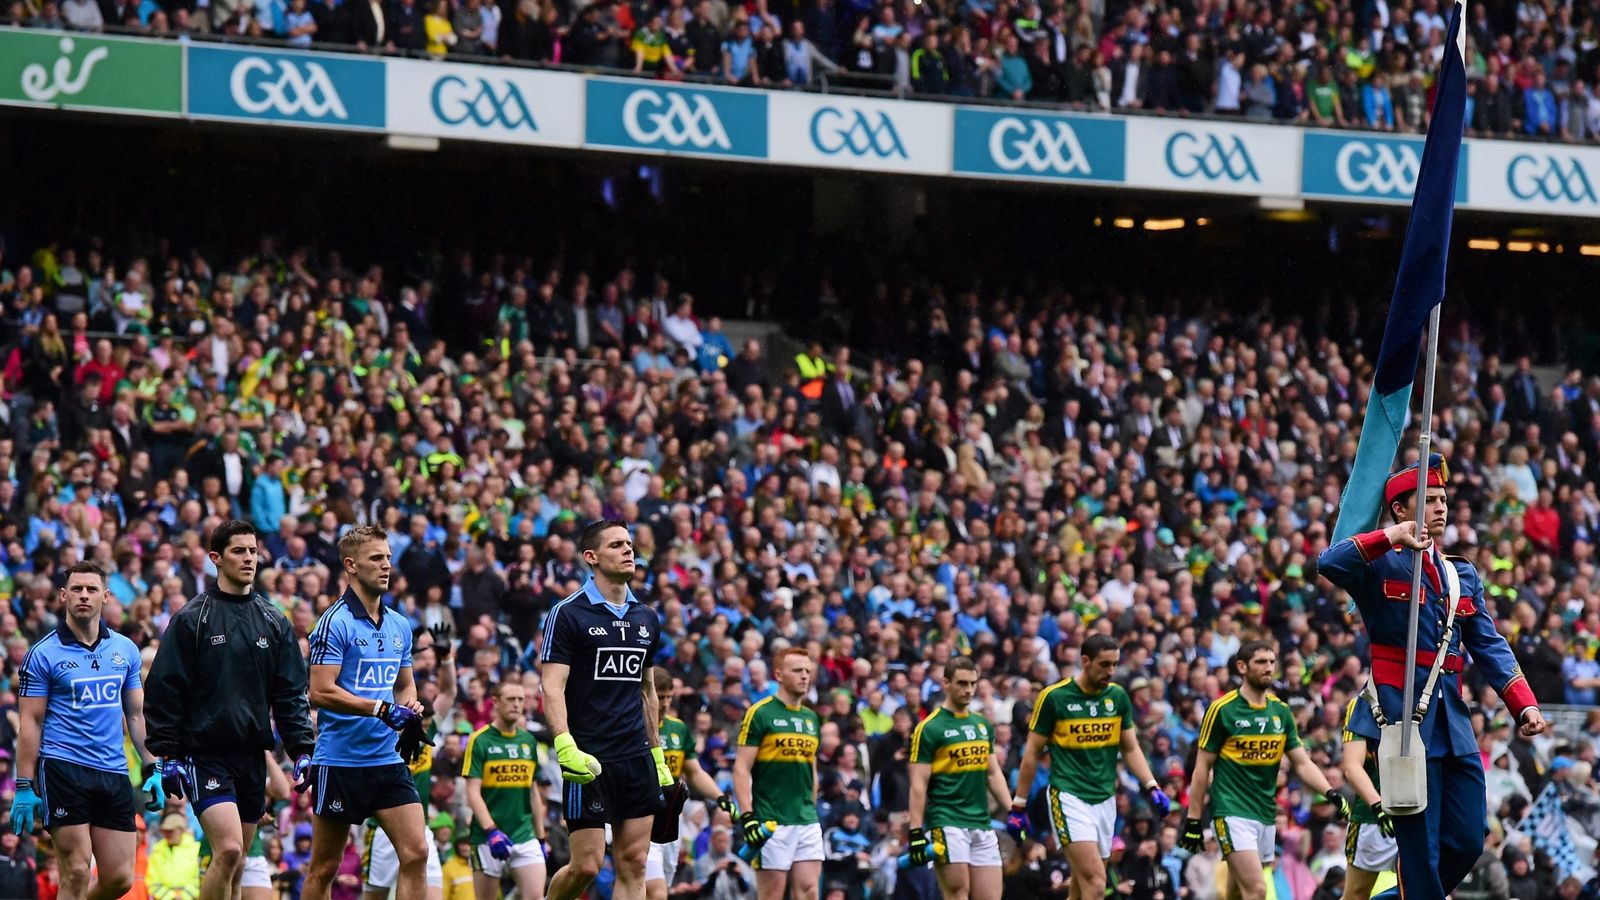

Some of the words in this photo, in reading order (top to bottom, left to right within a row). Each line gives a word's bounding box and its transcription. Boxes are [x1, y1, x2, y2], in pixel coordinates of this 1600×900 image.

[21, 38, 108, 100] eir
[230, 56, 348, 119] GAA
[430, 75, 539, 131] GAA
[622, 89, 732, 150] GAA
[809, 106, 909, 160] GAA
[988, 116, 1092, 175] GAA
[1164, 130, 1261, 182] GAA
[1506, 154, 1598, 204] GAA
[377, 639, 384, 652] 2
[620, 627, 626, 641] 1
[91, 659, 100, 671] 4
[362, 665, 397, 685] AIG
[601, 654, 641, 675] AIG
[81, 682, 118, 702] AIG
[1259, 722, 1266, 734] 7
